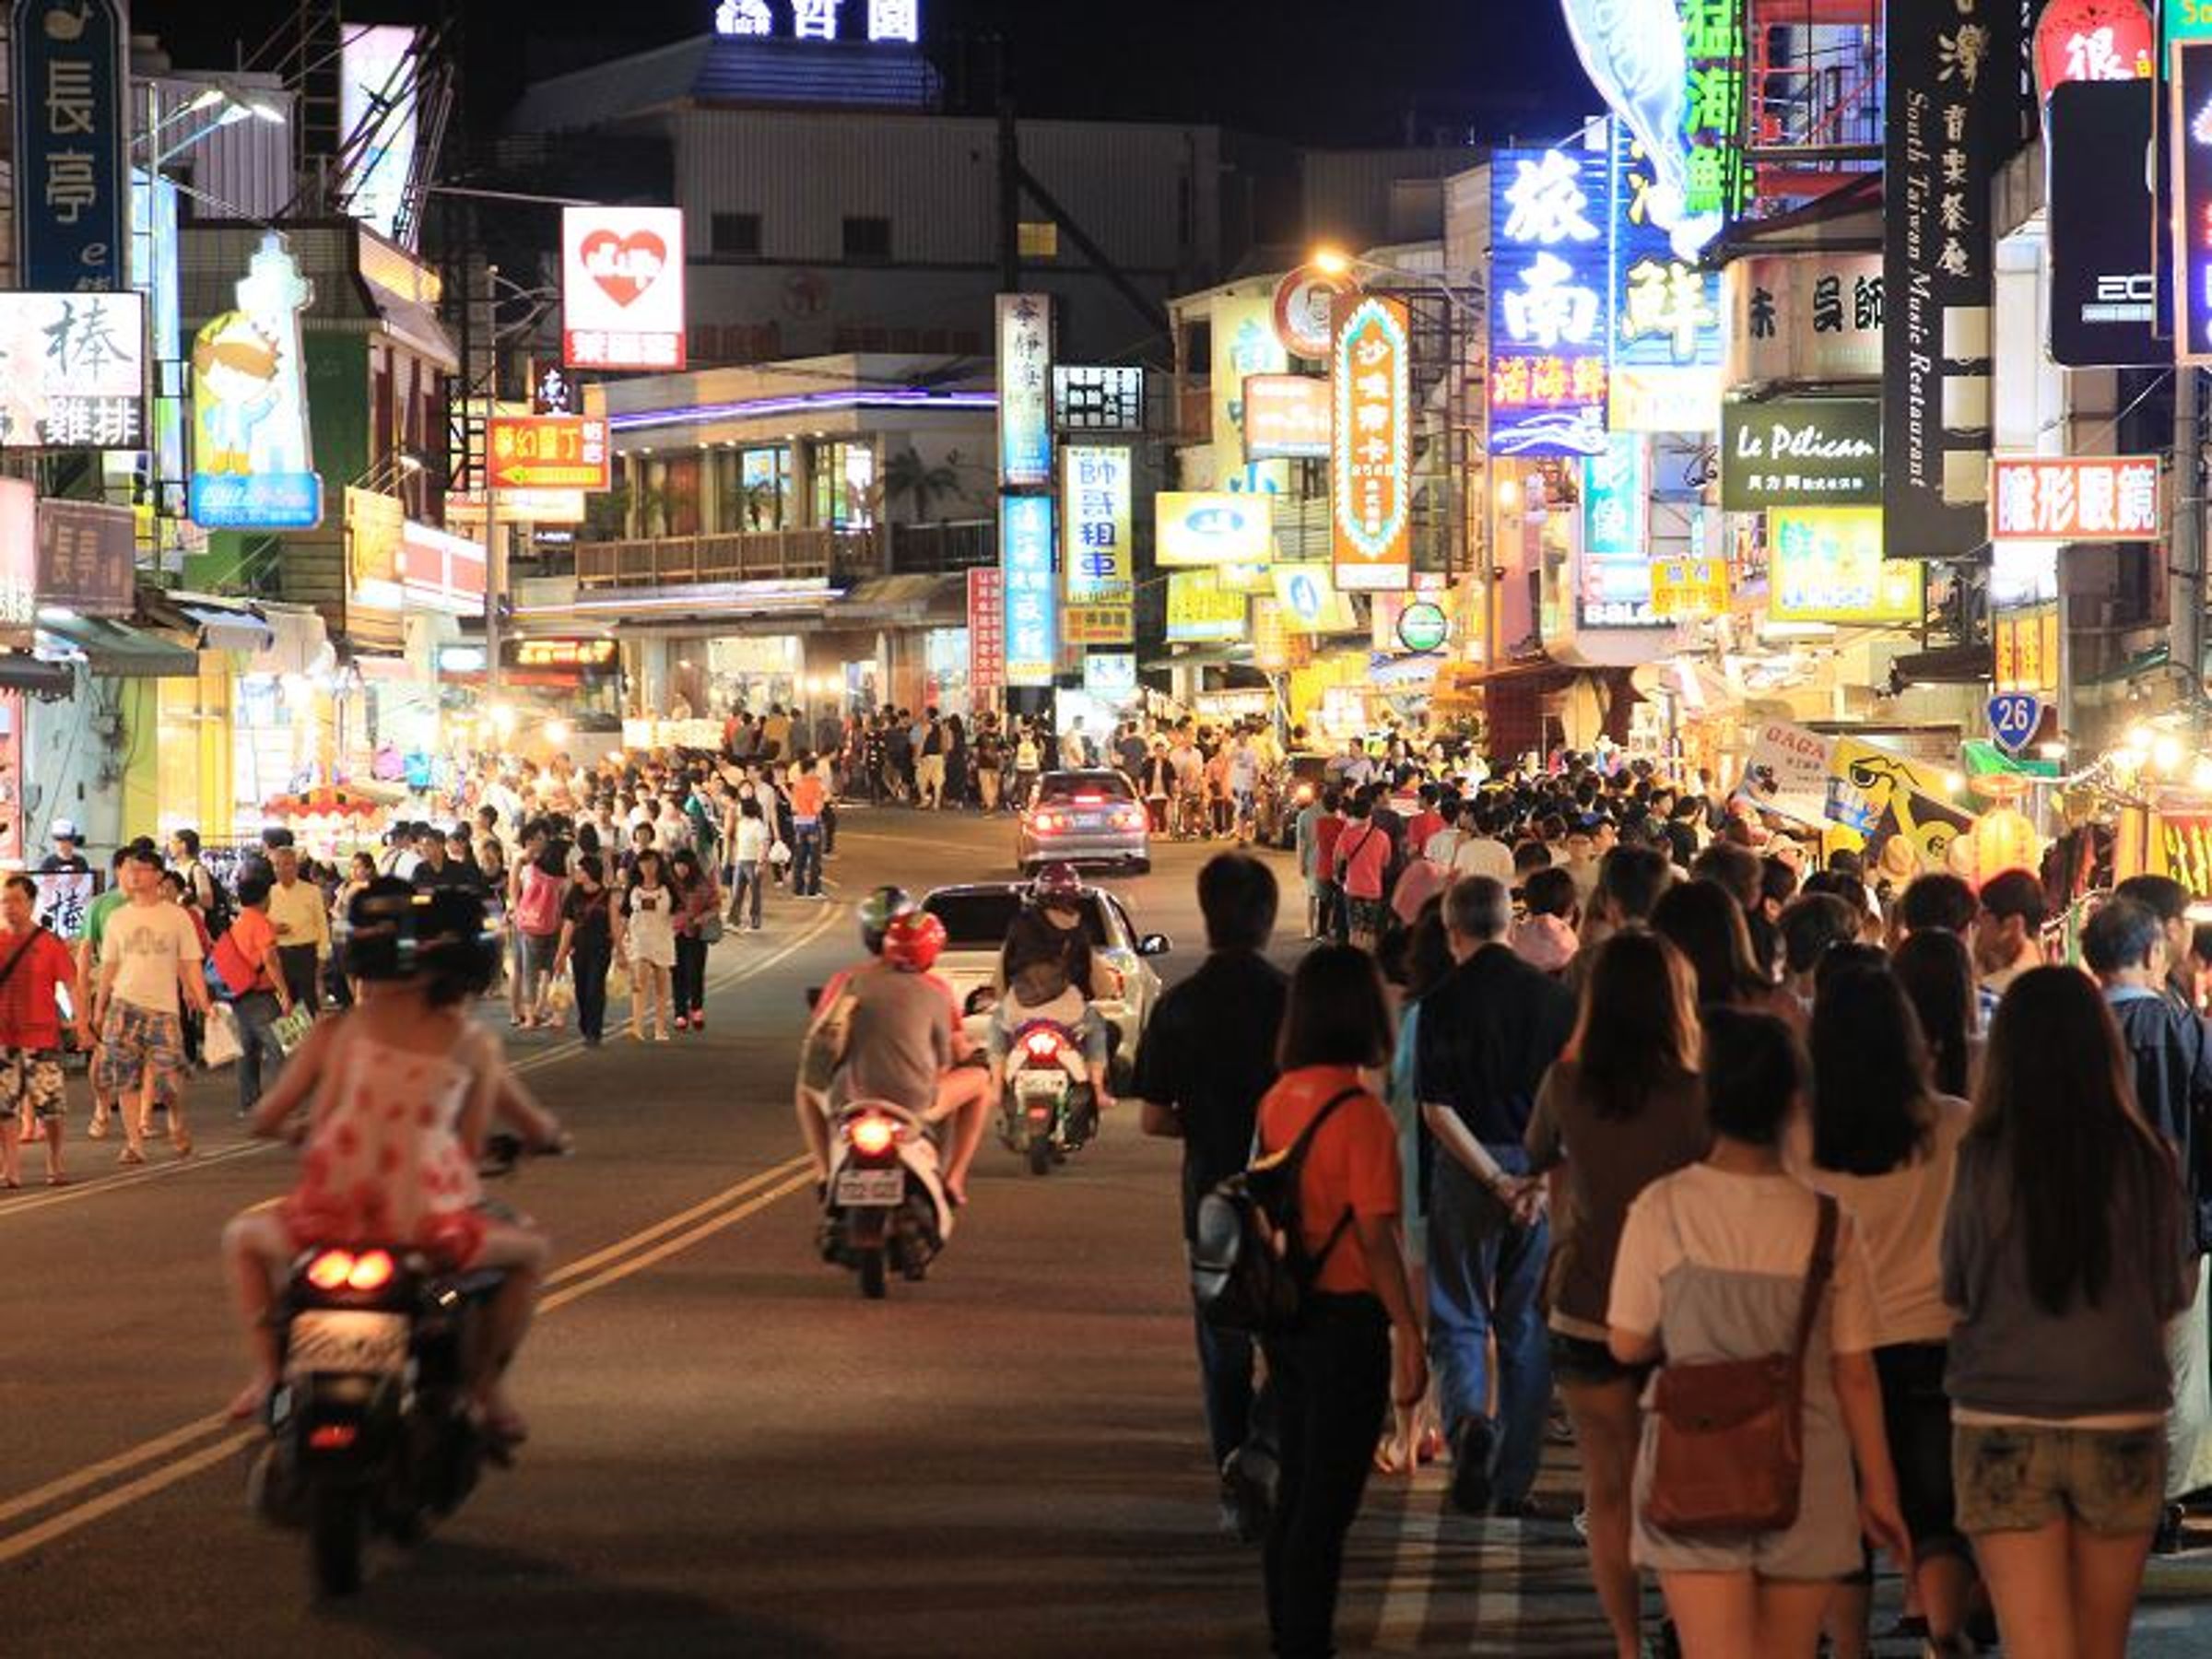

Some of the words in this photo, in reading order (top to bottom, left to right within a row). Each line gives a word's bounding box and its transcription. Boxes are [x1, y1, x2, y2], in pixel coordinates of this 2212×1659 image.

[1937, 0, 1990, 92] 灣
[1906, 88, 1932, 164] South
[1503, 148, 1601, 349] 旅南
[1906, 172, 1932, 260] Taiwan
[1907, 266, 1933, 347] Music
[45, 396, 140, 446] 雞排
[1737, 424, 1763, 458] Le
[1907, 355, 1933, 488] Restaurant
[1998, 465, 2155, 532] 隱形眼鏡
[1997, 698, 2029, 732] 26
